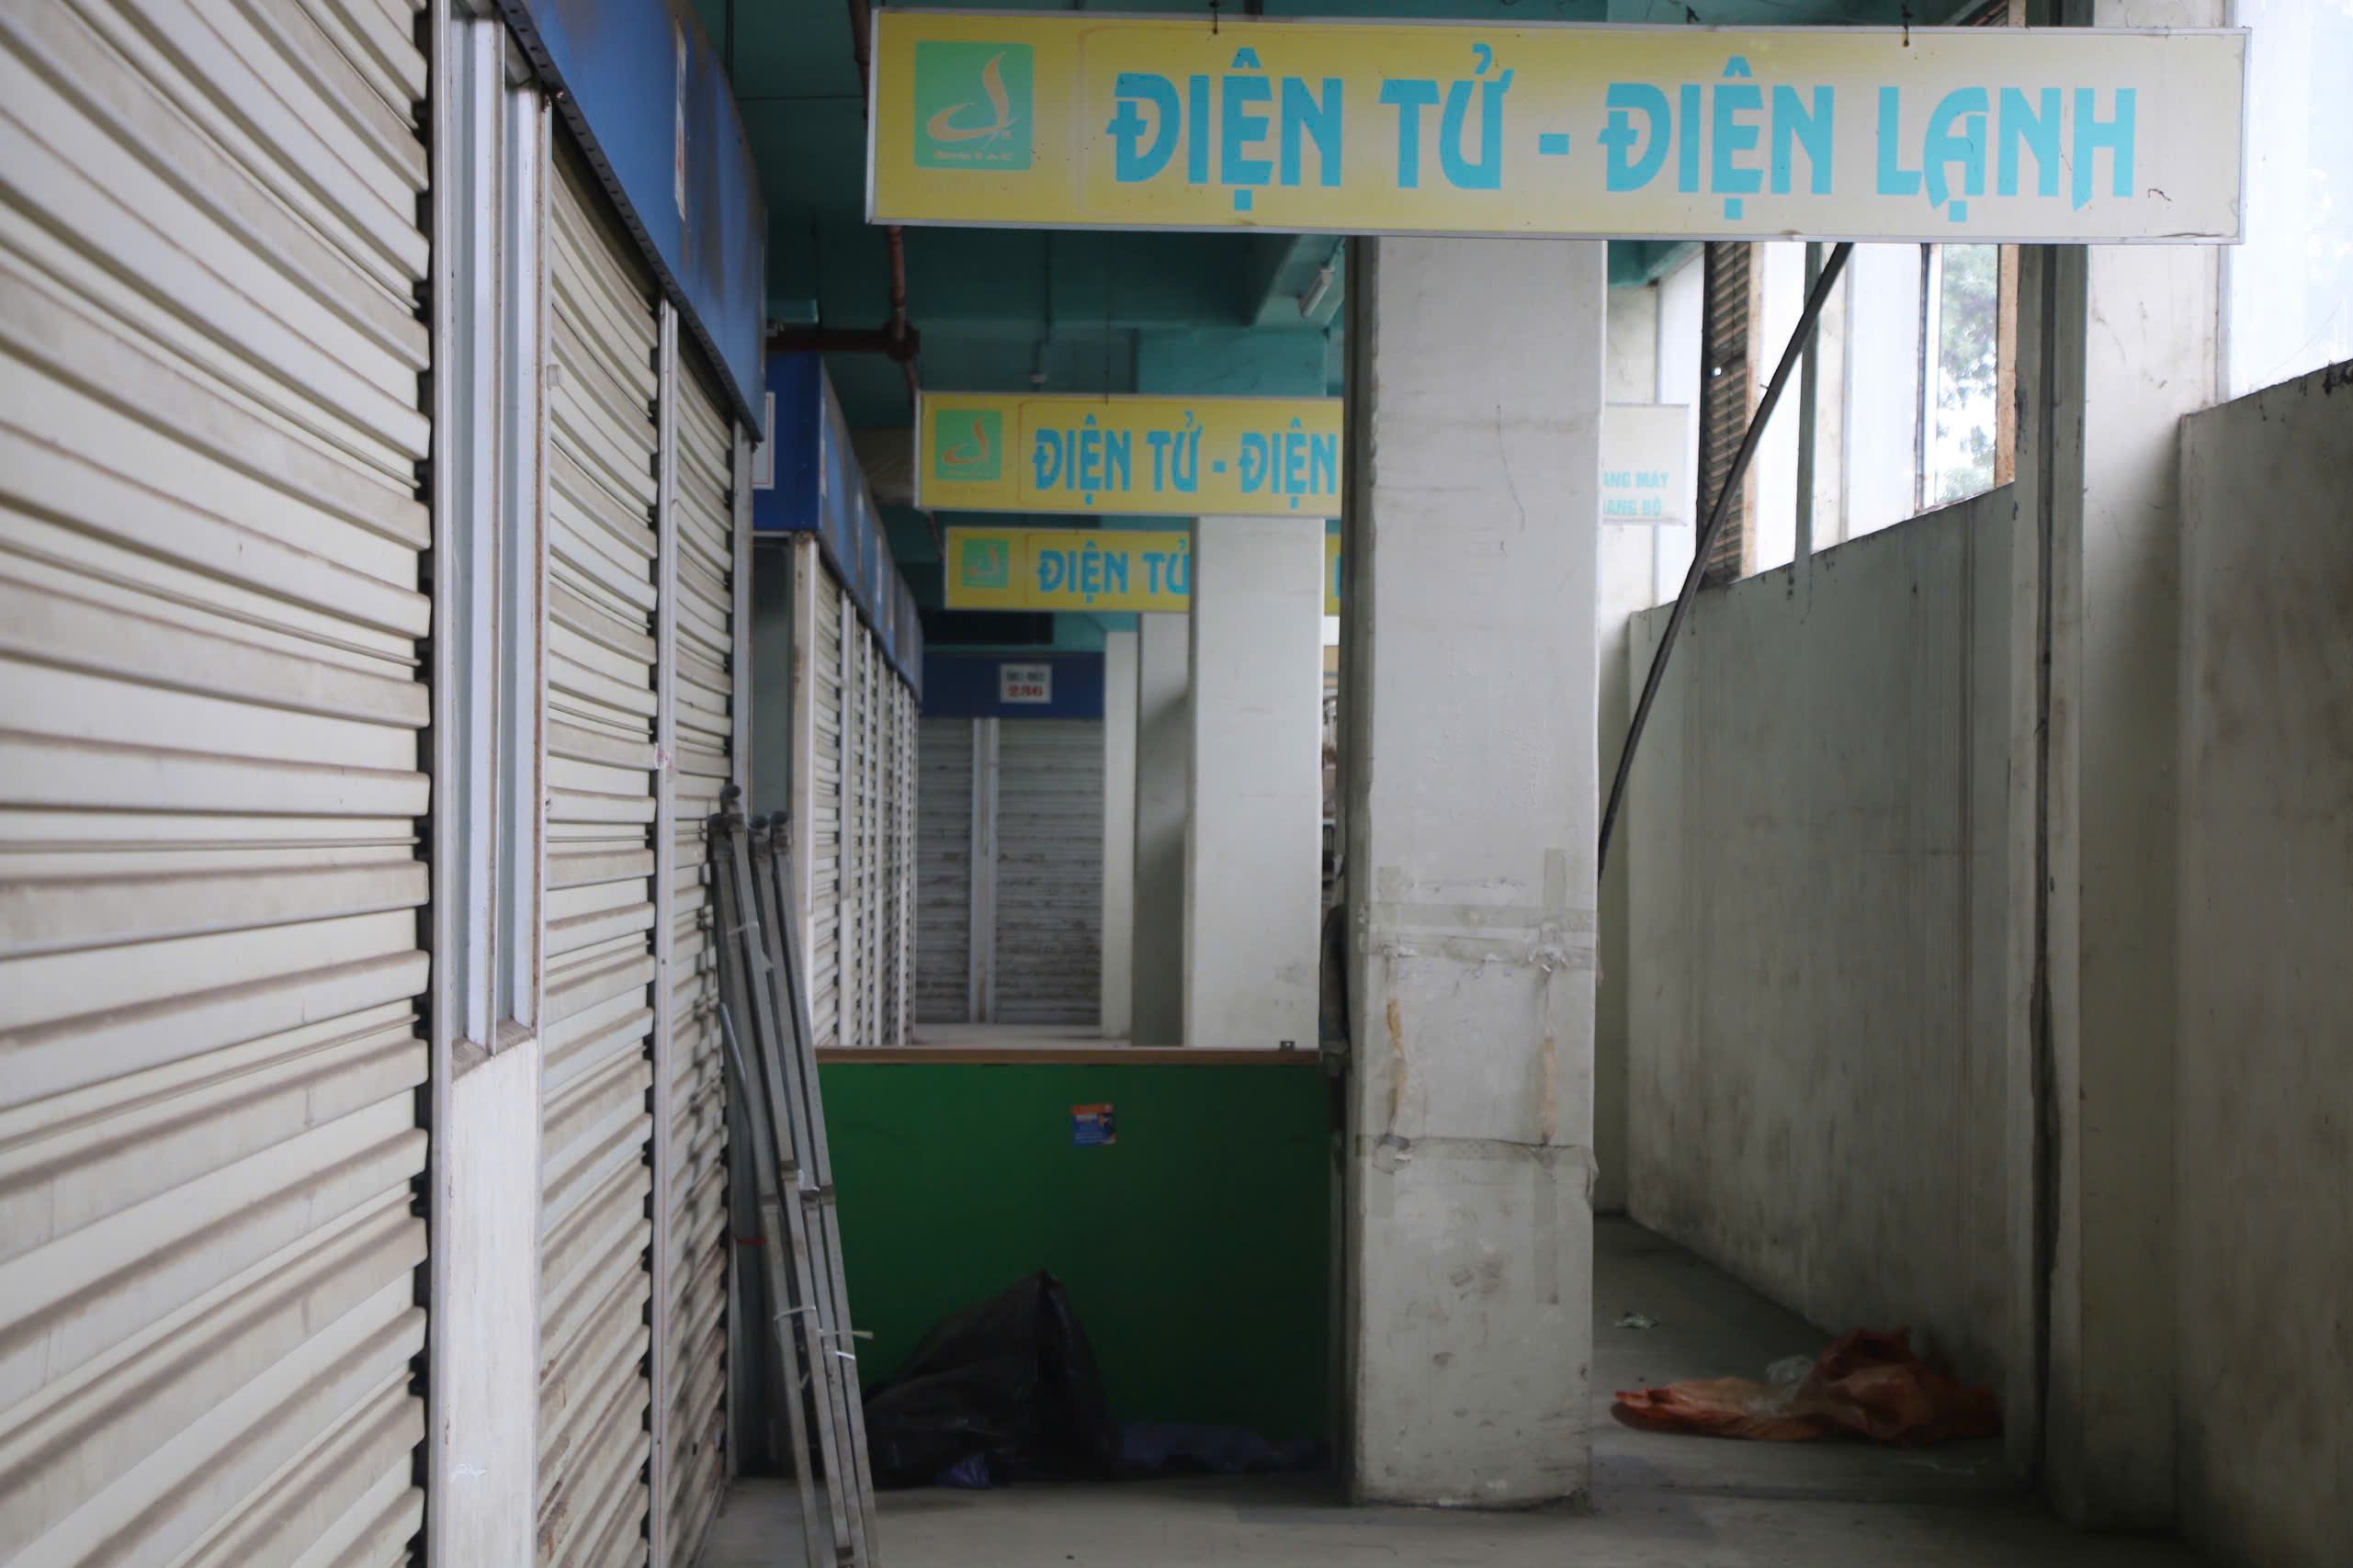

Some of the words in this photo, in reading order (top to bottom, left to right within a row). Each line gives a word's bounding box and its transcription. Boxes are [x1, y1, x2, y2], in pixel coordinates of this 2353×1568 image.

[1106, 48, 1343, 212] ĐIỆN
[1379, 43, 1515, 190] TỬ
[1538, 133, 1569, 155] -
[1596, 56, 1835, 220] ĐIỆN
[1875, 86, 2137, 222] LẠNH
[1033, 413, 1131, 506] ĐIỆN
[1146, 410, 1204, 493] TỬ
[1237, 417, 1338, 509] ĐIỆN
[1037, 540, 1129, 604] ĐIỆN
[1142, 539, 1190, 595] TỬ
